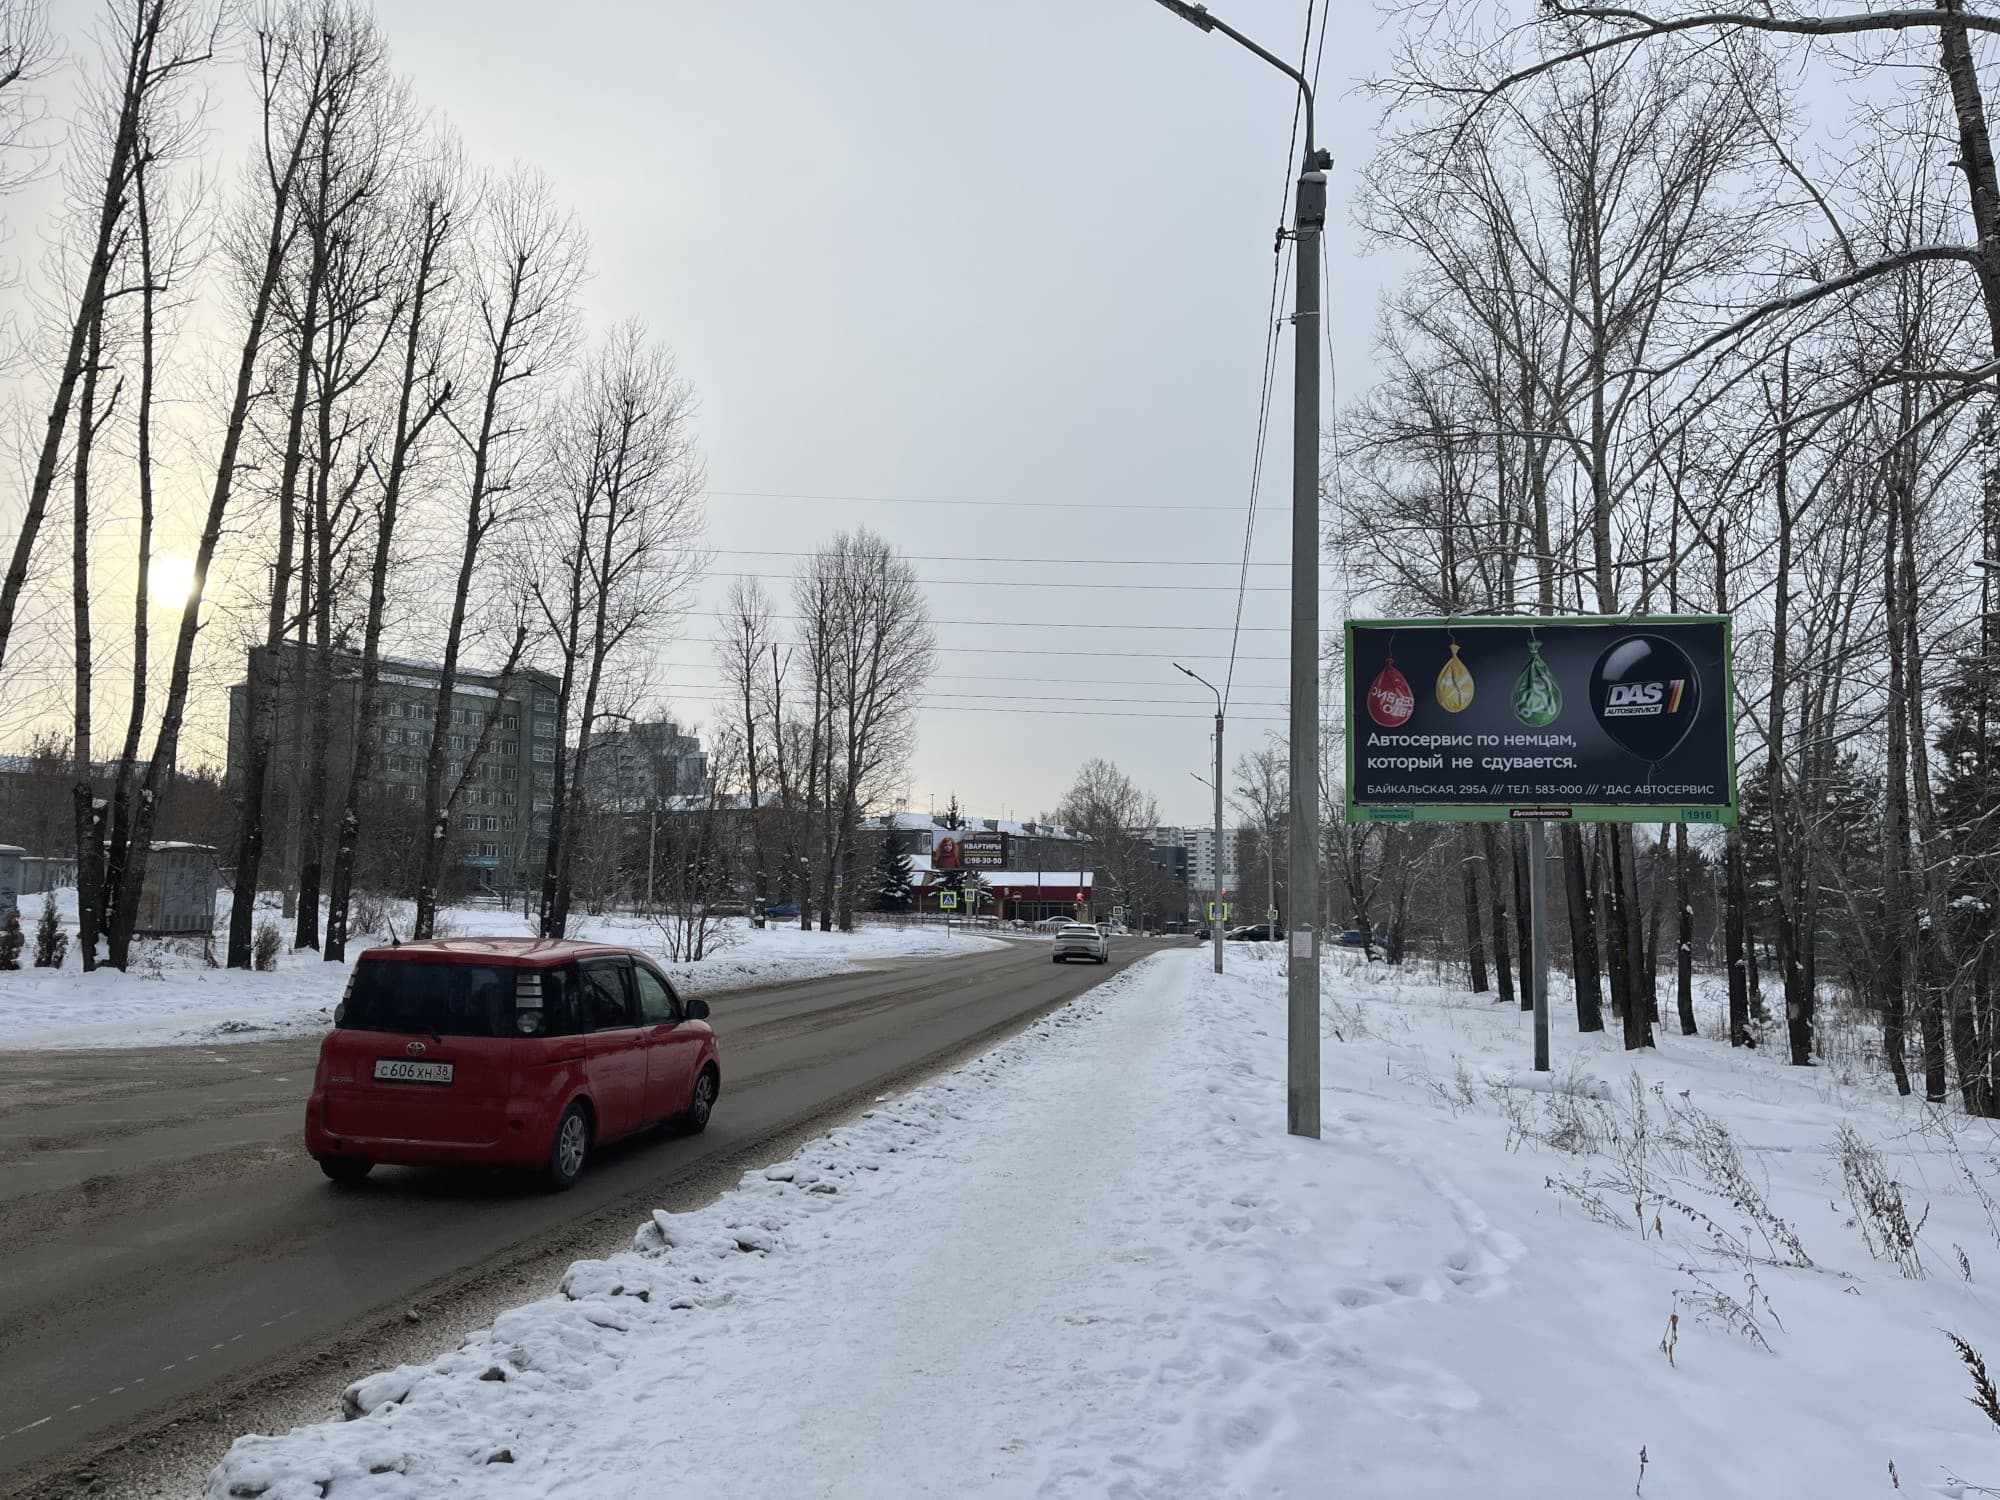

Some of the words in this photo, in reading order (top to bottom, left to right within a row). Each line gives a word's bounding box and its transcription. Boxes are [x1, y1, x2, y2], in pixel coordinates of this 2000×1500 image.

[1609, 682, 1664, 706] DAS
[1606, 706, 1661, 715] AUTOSERVICE
[1367, 732, 1473, 750] Автосервис
[1477, 734, 1500, 746] по
[1504, 734, 1577, 748] немцам,
[1367, 753, 1443, 772] который
[1451, 757, 1474, 769] не
[1482, 757, 1578, 772] сдувается.
[1367, 784, 1457, 795] БАЙКАЛЬСКАЯ,
[1459, 785, 1488, 794] 295А
[1507, 785, 1532, 794] ТЕЛ:
[1535, 785, 1583, 794] 583-000
[1634, 785, 1715, 795] АВТОСЕРВИС
[1687, 811, 1713, 820] 1916
[436, 1065, 449, 1076] 38
